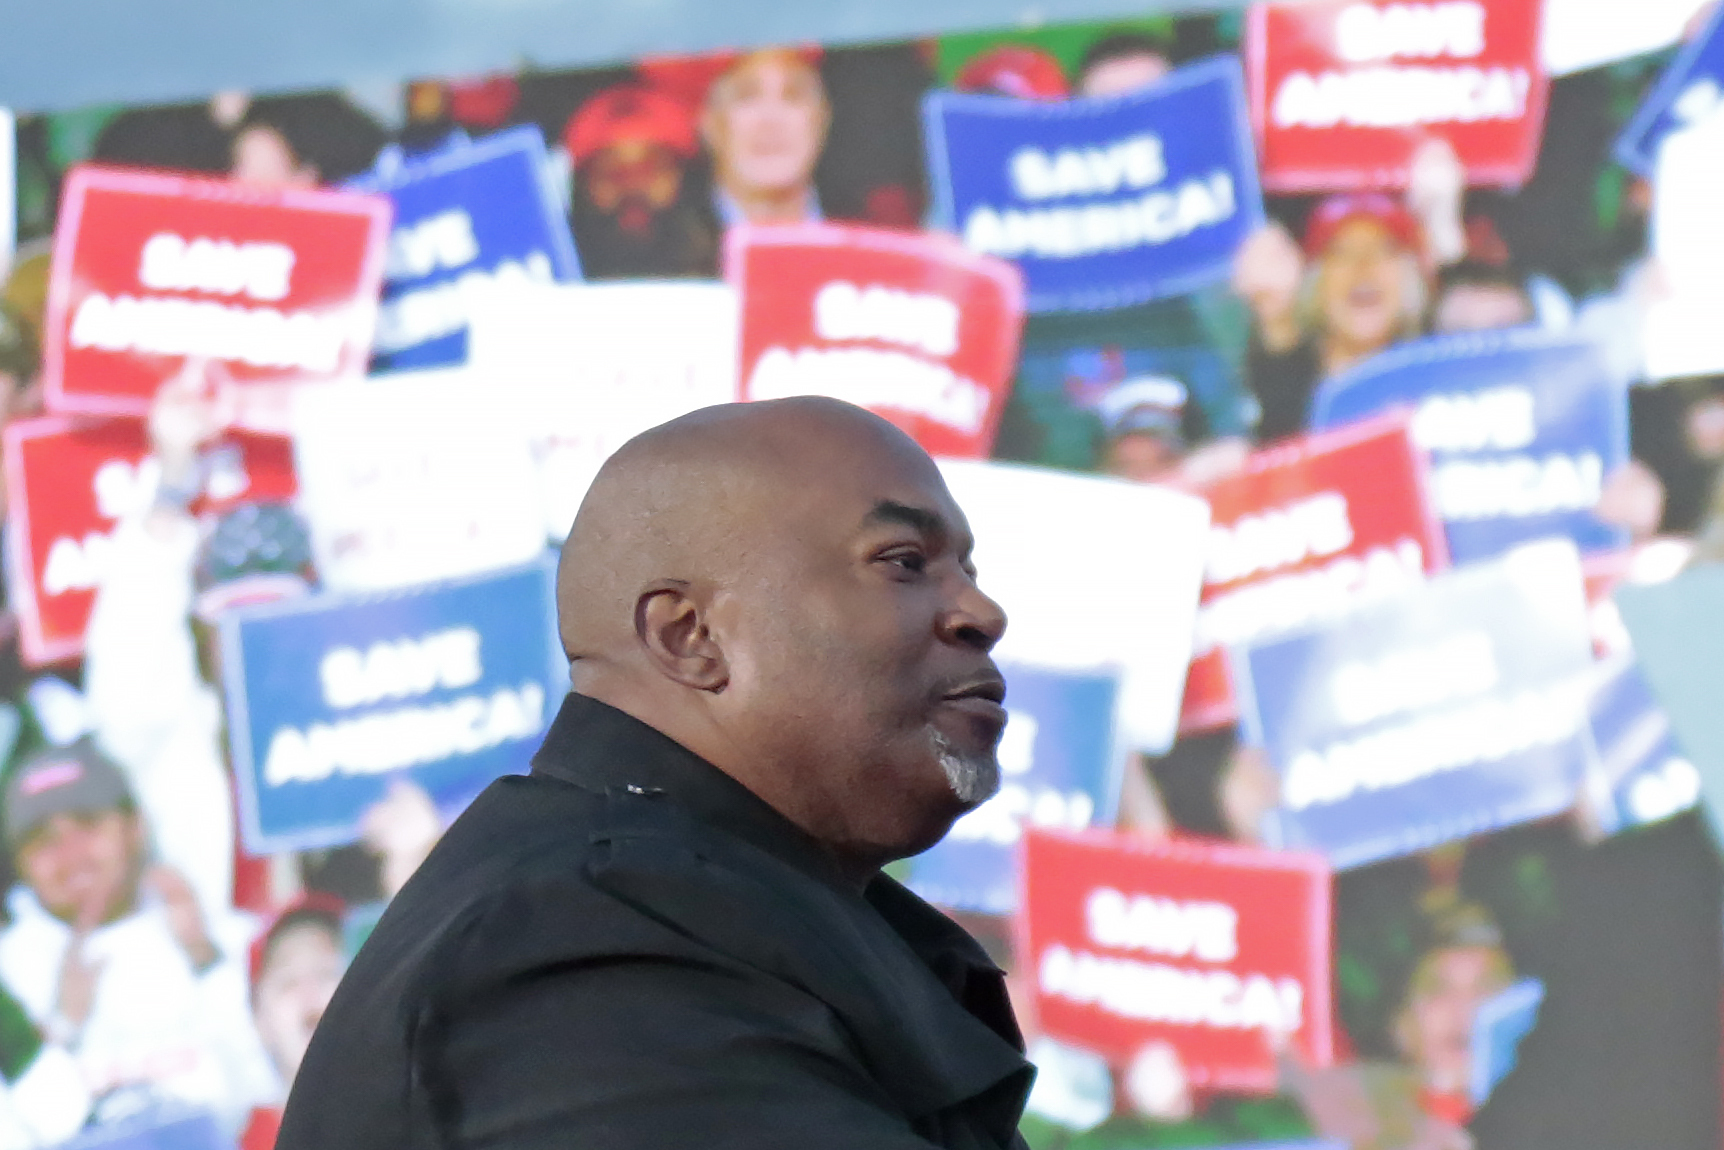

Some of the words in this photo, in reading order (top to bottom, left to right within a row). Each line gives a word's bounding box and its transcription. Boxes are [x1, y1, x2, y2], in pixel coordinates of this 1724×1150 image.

[1335, 3, 1486, 62] SAVE
[1010, 135, 1166, 201] SAVE
[964, 172, 1235, 260] AMERICA!
[321, 627, 481, 709] SAVE
[265, 682, 546, 787] AMERICA!
[1088, 889, 1237, 963] SAVE
[1039, 946, 1304, 1033] AMERICA!
